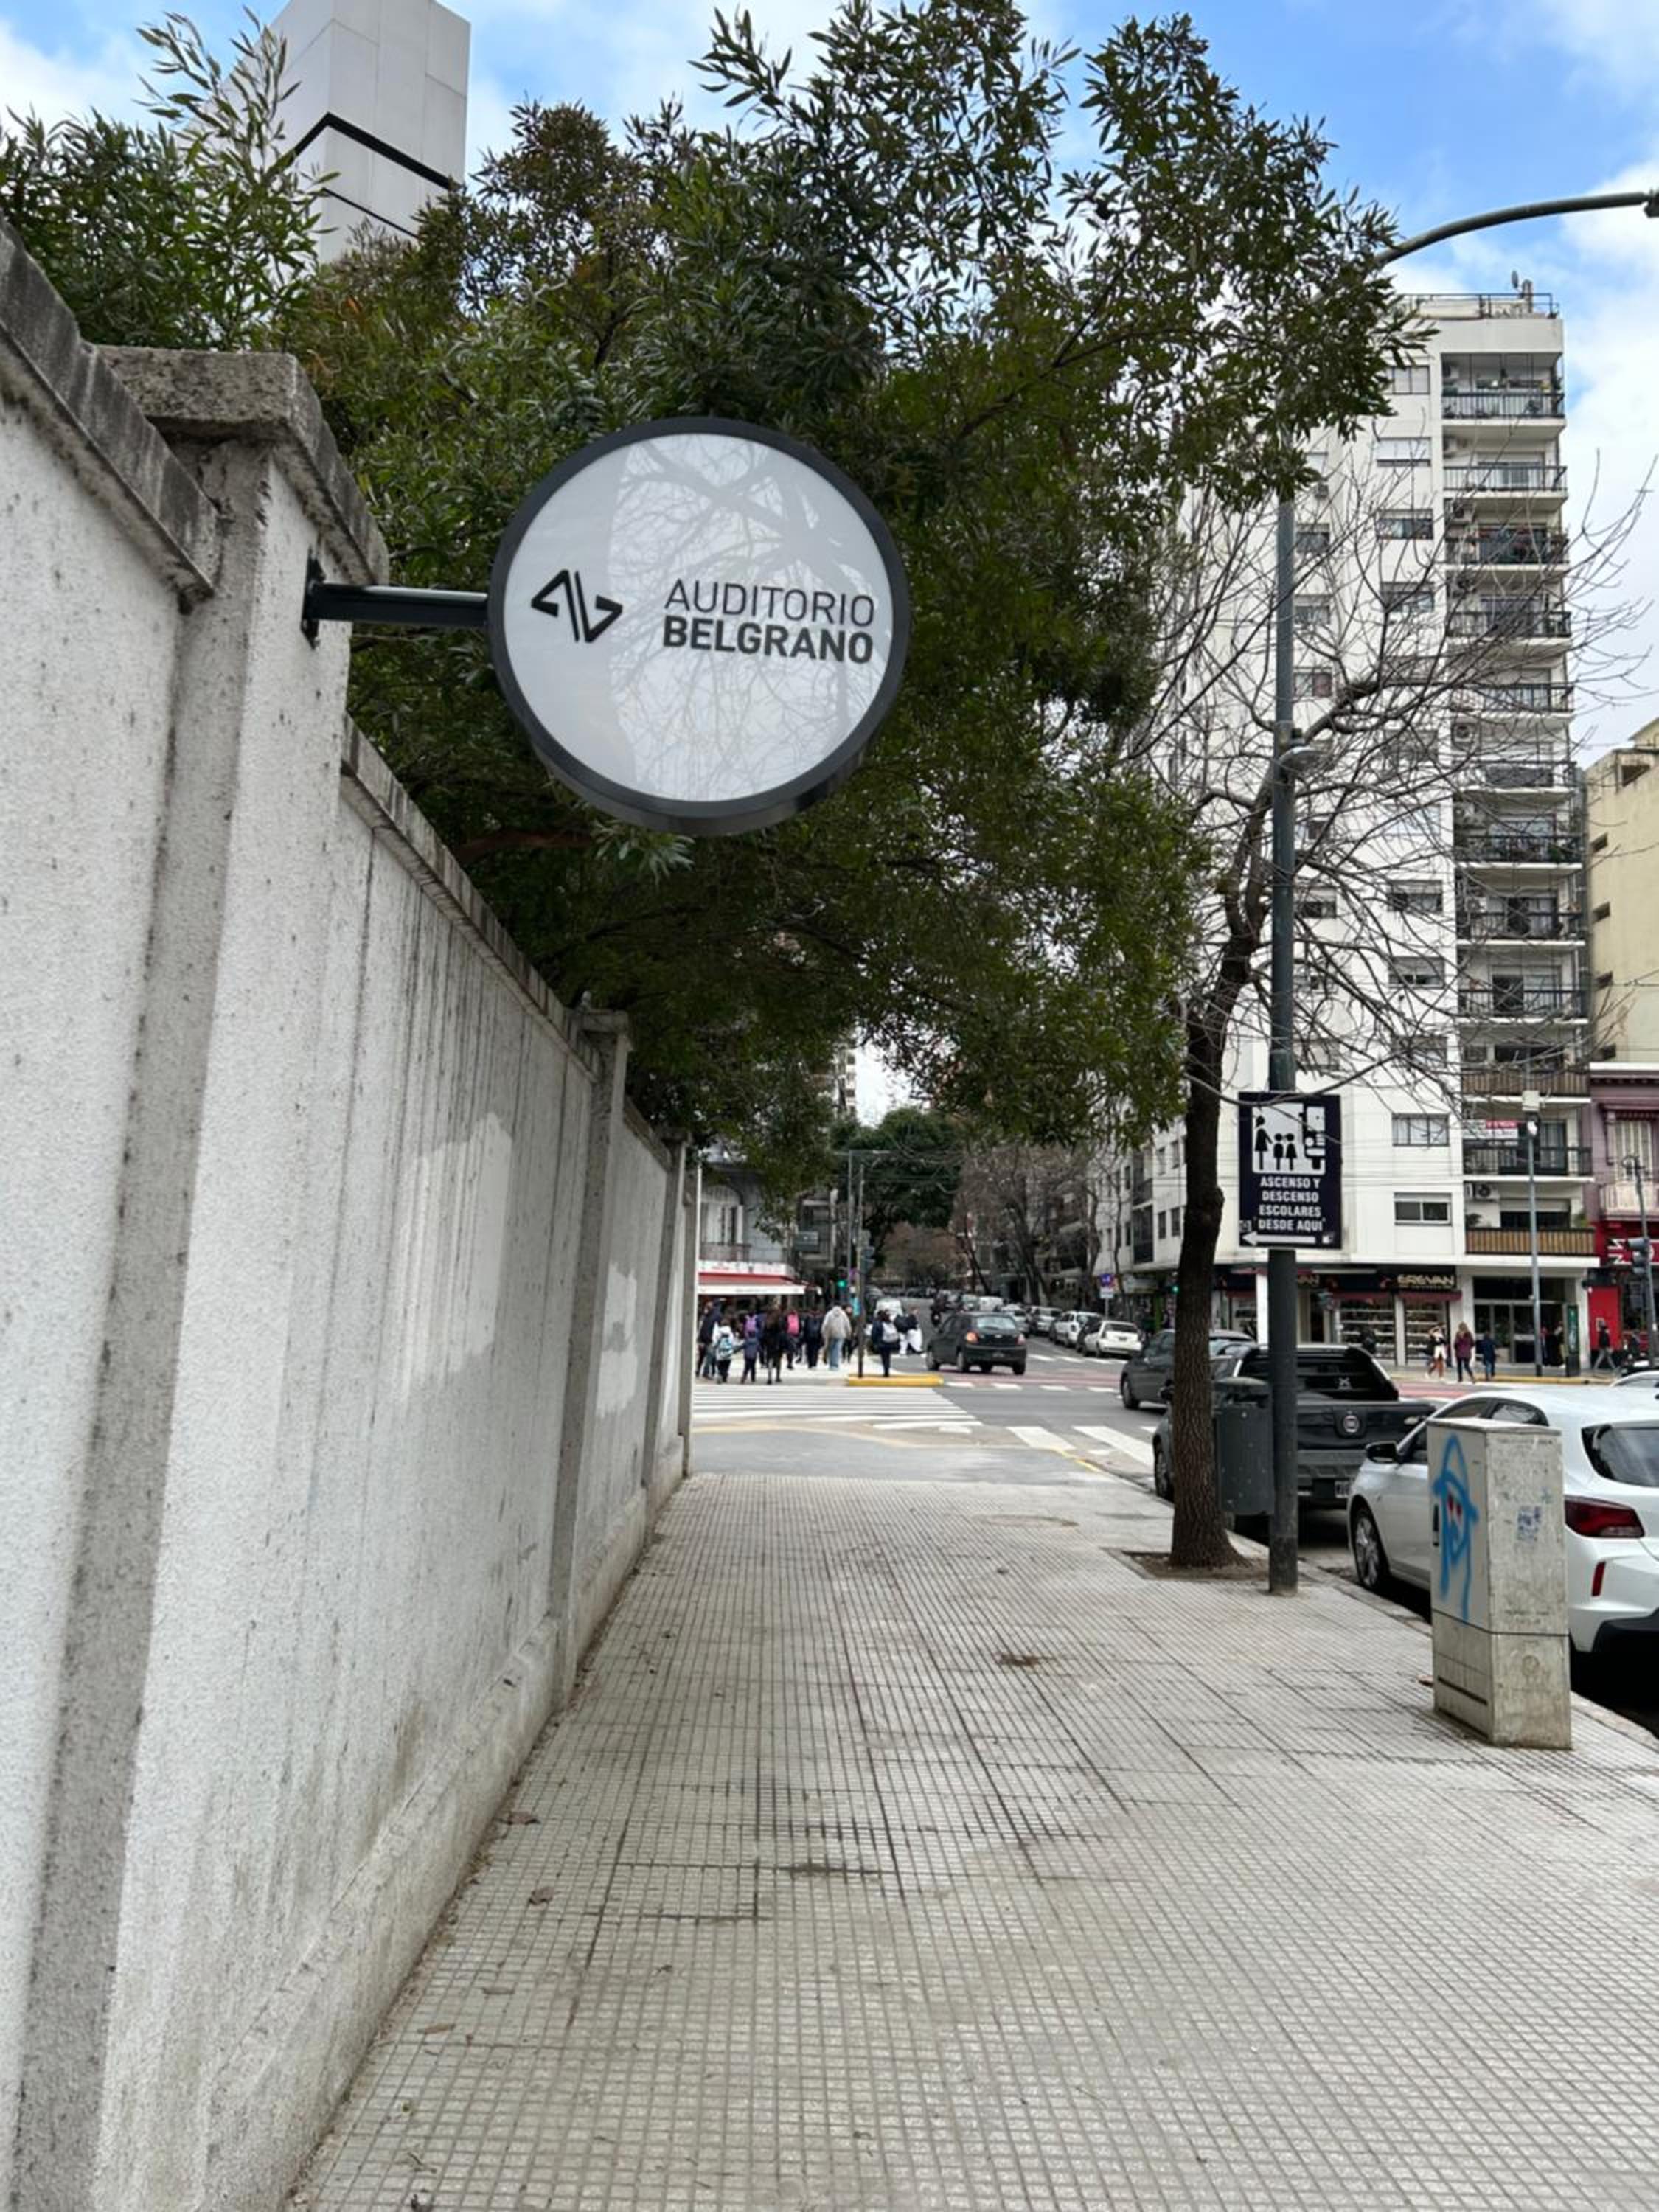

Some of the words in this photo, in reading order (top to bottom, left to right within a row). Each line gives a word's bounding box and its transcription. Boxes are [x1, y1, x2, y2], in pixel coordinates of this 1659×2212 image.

[664, 578, 874, 627] AUDITORIO
[663, 615, 874, 664] BELGRANO
[1260, 1176, 1310, 1189] ASCENSO
[1313, 1178, 1321, 1189] Y
[1262, 1190, 1319, 1203] DESCENSO
[1259, 1204, 1321, 1217] ESCOLARES
[1258, 1219, 1294, 1231] DESDE
